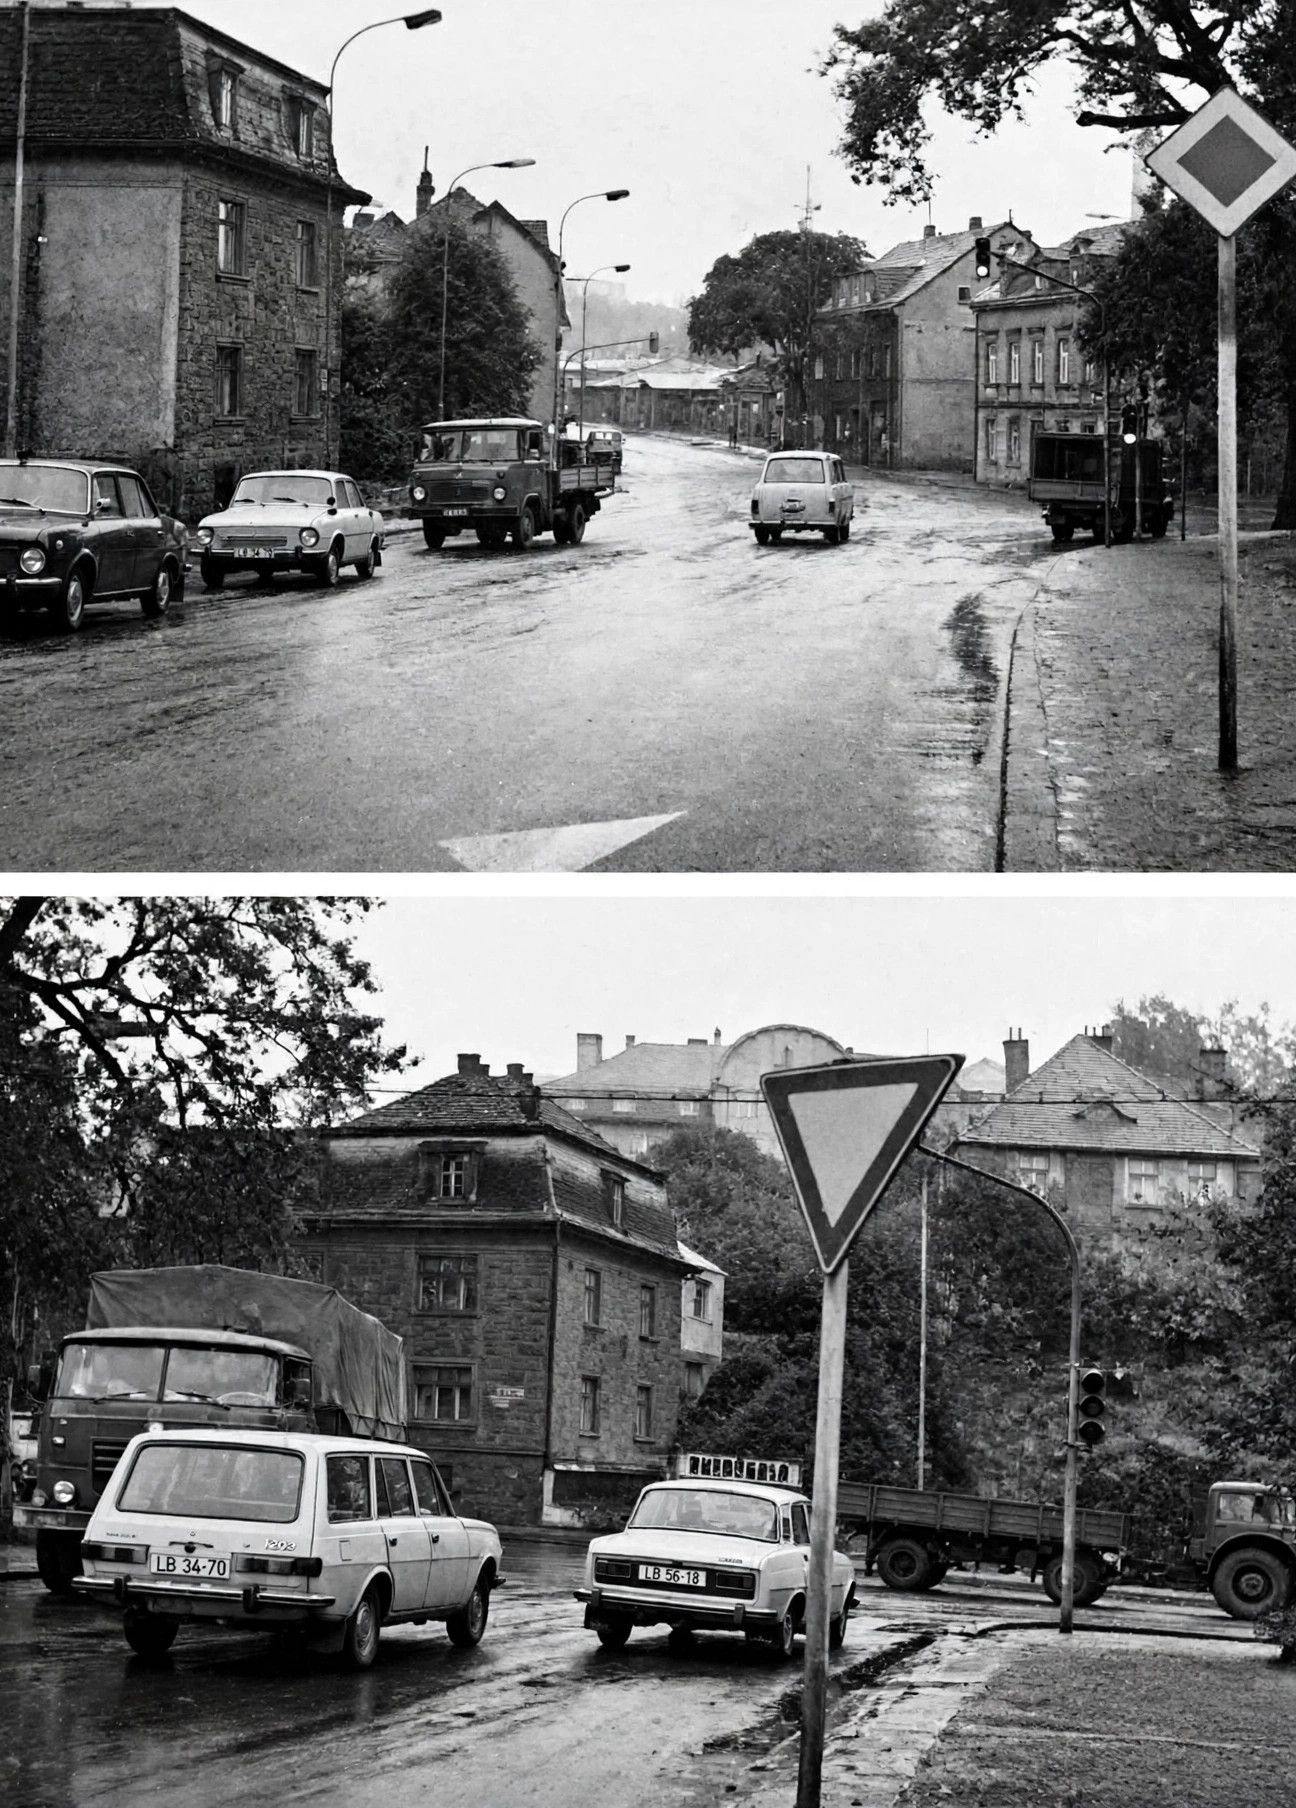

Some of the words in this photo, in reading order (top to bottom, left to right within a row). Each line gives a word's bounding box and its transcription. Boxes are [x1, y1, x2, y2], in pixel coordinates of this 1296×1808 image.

[156, 1556, 176, 1572] LB
[182, 1558, 226, 1576] 34-70
[645, 1567, 660, 1580] LB
[665, 1569, 700, 1585] 56-18
